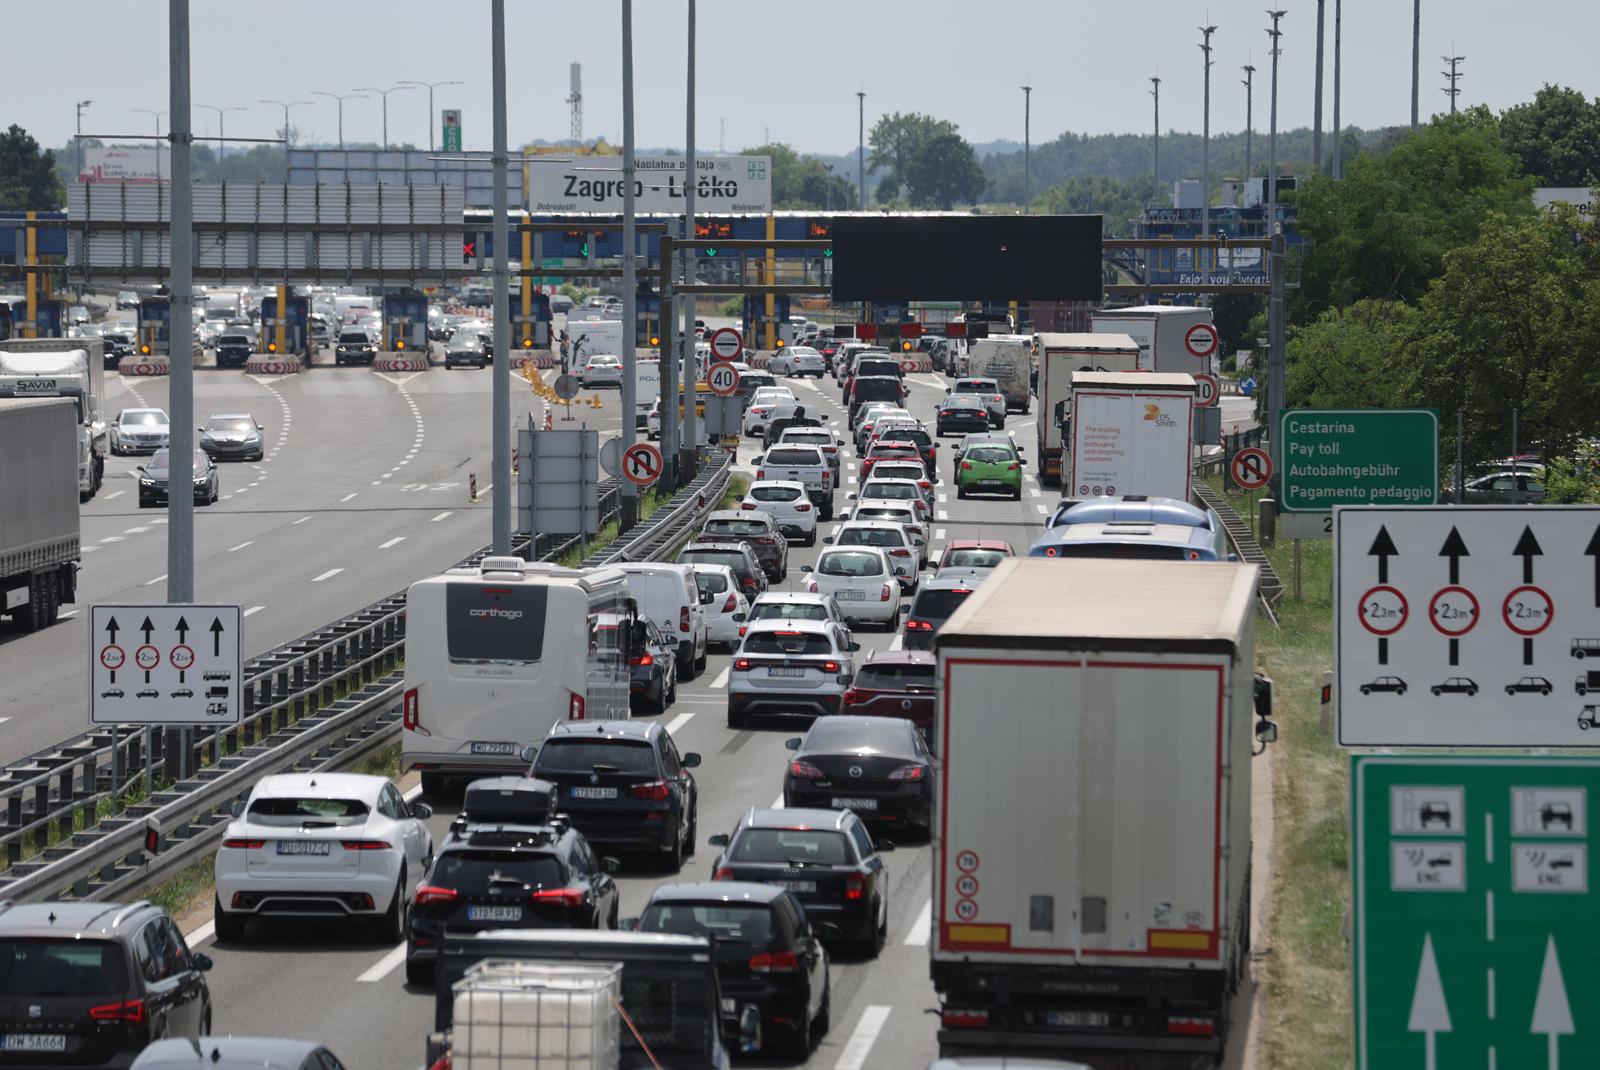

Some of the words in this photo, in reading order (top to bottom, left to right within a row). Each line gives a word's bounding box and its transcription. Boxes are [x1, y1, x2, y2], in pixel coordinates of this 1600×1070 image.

[714, 371, 732, 386] 40
[1155, 419, 1177, 427] Smith
[1290, 421, 1355, 433] Cestarina
[1290, 442, 1314, 458] Pay
[1319, 442, 1339, 454] toll
[1290, 464, 1400, 478] Autobahngebühr
[1290, 485, 1366, 500] Pagamento
[1371, 485, 1432, 500] pedaggio
[470, 609, 522, 619] carthago
[1417, 873, 1441, 883] ENC
[1537, 874, 1562, 885] ENC
